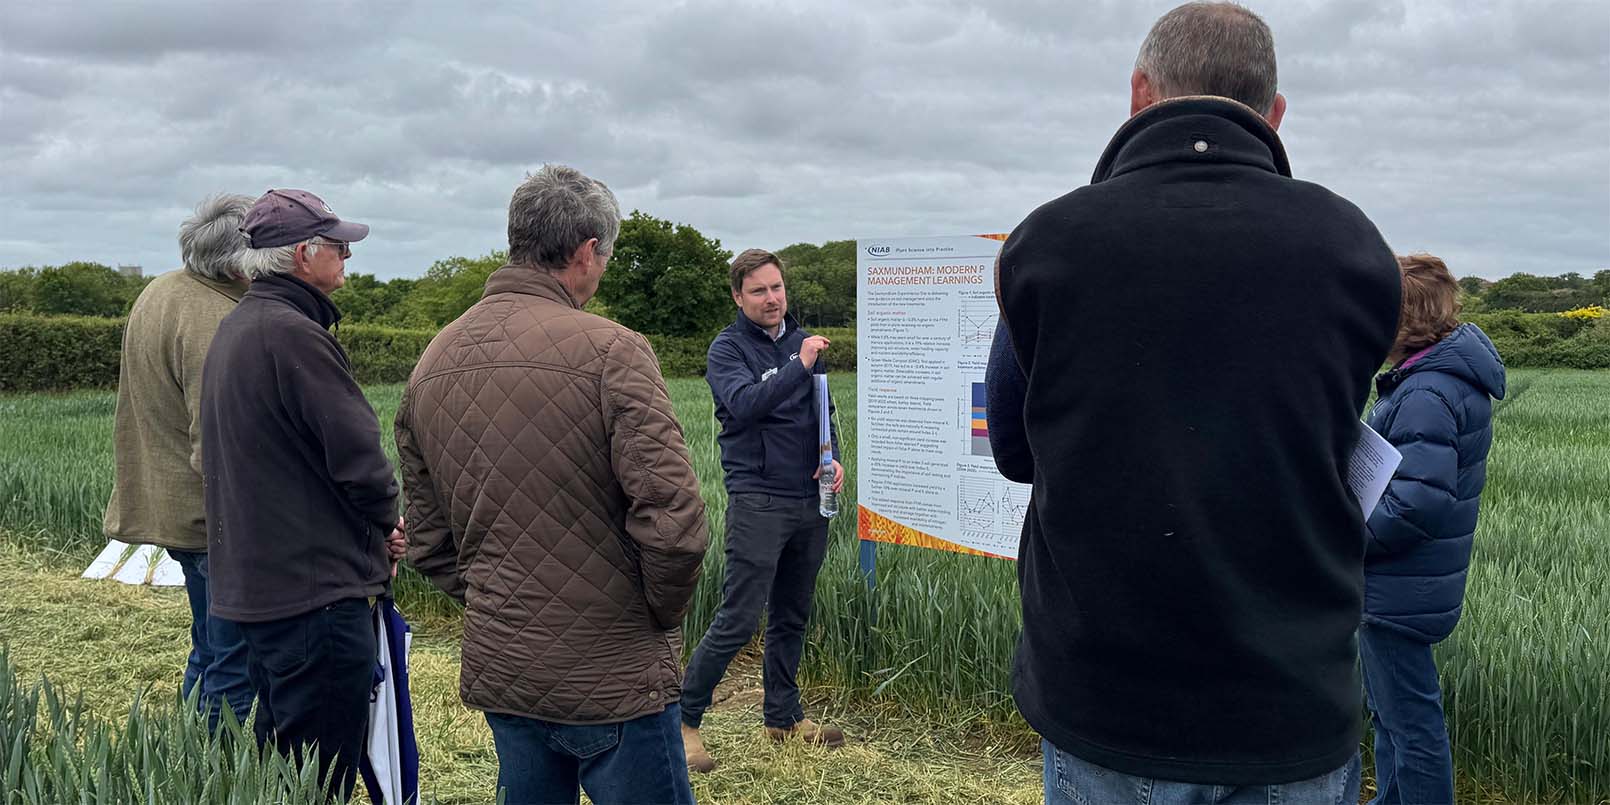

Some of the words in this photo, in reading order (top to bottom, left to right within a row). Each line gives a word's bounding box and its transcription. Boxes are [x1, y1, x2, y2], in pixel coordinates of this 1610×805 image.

[869, 246, 890, 255] NIAB
[868, 267, 934, 275] SAXMUNDHAM:
[937, 265, 977, 274] MODERN
[979, 265, 984, 273] P
[868, 276, 931, 285] MANAGEMENT
[933, 275, 983, 284] LEARNINGS
